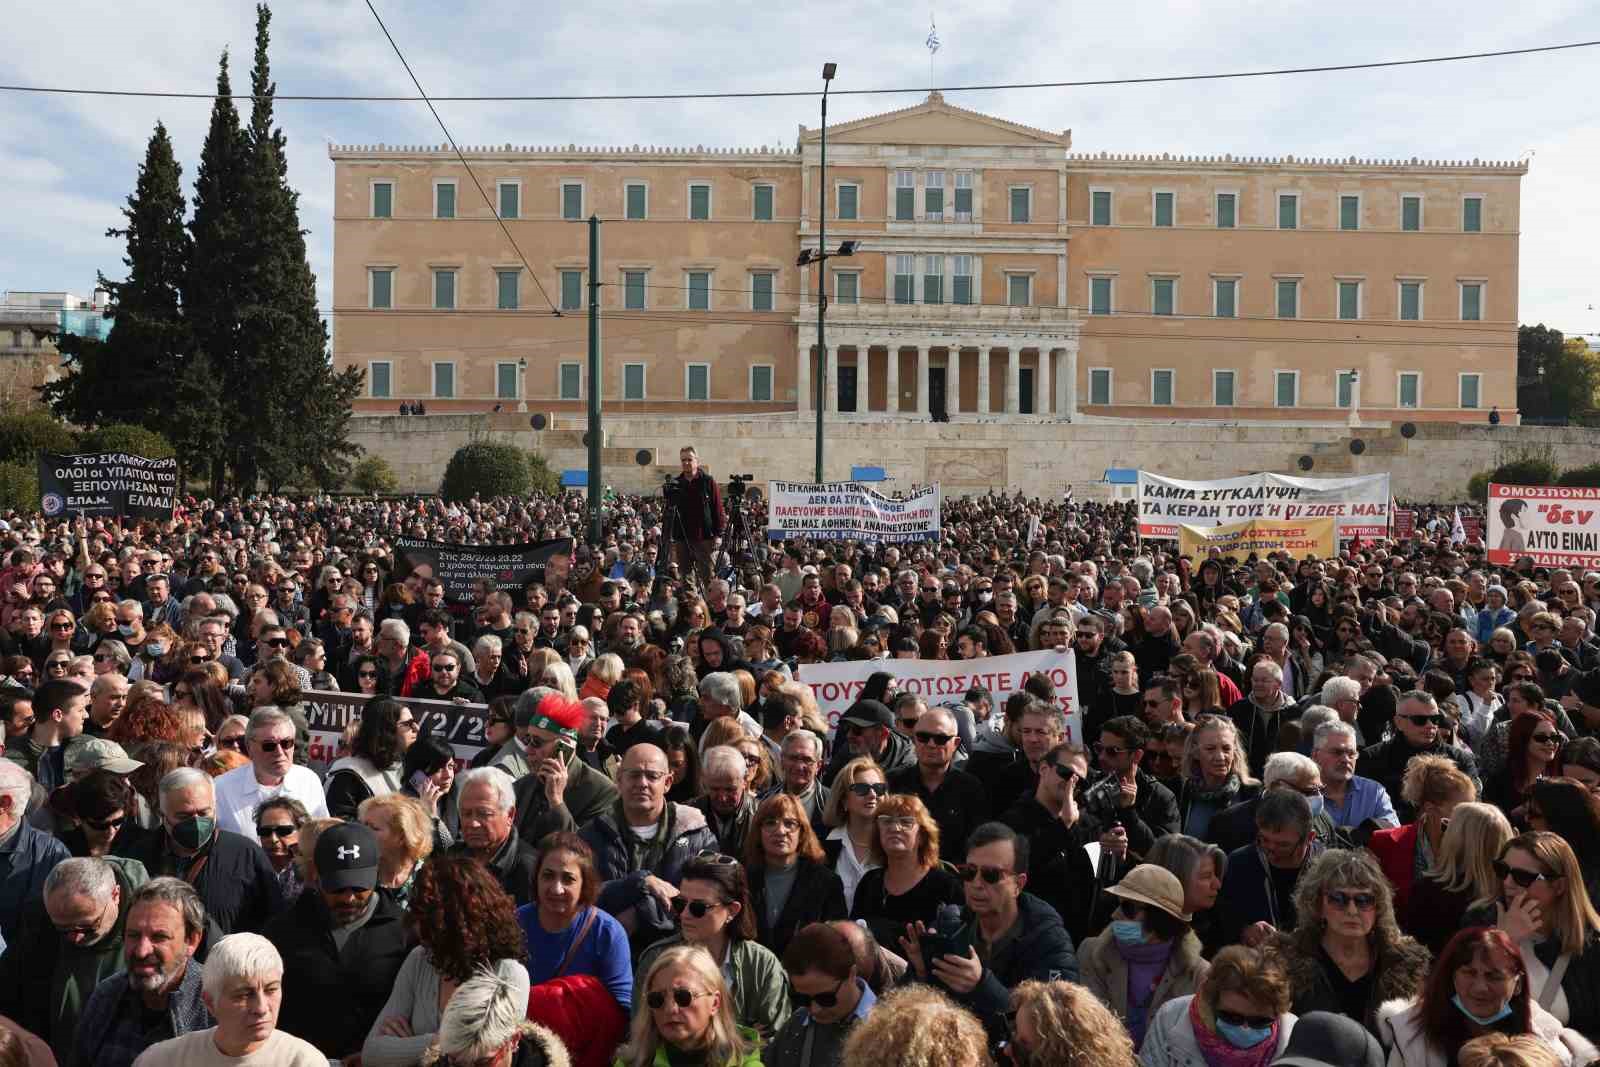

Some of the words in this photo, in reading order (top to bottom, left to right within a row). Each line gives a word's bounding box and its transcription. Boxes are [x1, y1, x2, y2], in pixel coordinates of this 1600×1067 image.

[55, 468, 87, 479] ΟΛΟΙ
[90, 469, 103, 478] οι
[73, 480, 158, 494] ΞΕΠΟΥΛΗΣΑΝ
[159, 486, 175, 496] τη
[776, 483, 786, 493] ΤΟ
[788, 483, 827, 493] ΕΓΚΛΗΜΑ
[829, 484, 843, 493] ΣΤΑ
[1144, 484, 1198, 500] ΚΑΜΙΑ
[1200, 486, 1301, 501] ΣΥΓΚΑΛΥΨΗ
[808, 495, 827, 504] ΔΕΝ
[830, 495, 842, 504] ΘΑ
[775, 506, 826, 517] ΠΑΛΕΥΟΥΜΕ
[919, 509, 933, 519] ΠΟΥ
[1142, 501, 1162, 515] ΤΑ
[1166, 503, 1221, 517] ΚΕΡΔΗ
[1226, 504, 1264, 517] ΤΟΥΣ
[1304, 504, 1347, 517] ΖΩΕΣ
[1351, 503, 1387, 516] ΜΑΣ
[801, 519, 819, 528] ΜΑΣ
[851, 519, 862, 529] ΝΑ
[1527, 530, 1558, 549] ΑΥΤΟ
[1562, 532, 1598, 552] ΕΙΝΑΙ
[439, 552, 458, 561] Στις
[498, 554, 523, 562] 23.22
[897, 673, 1013, 697] ΚΟΤΩΣΑΤΕ
